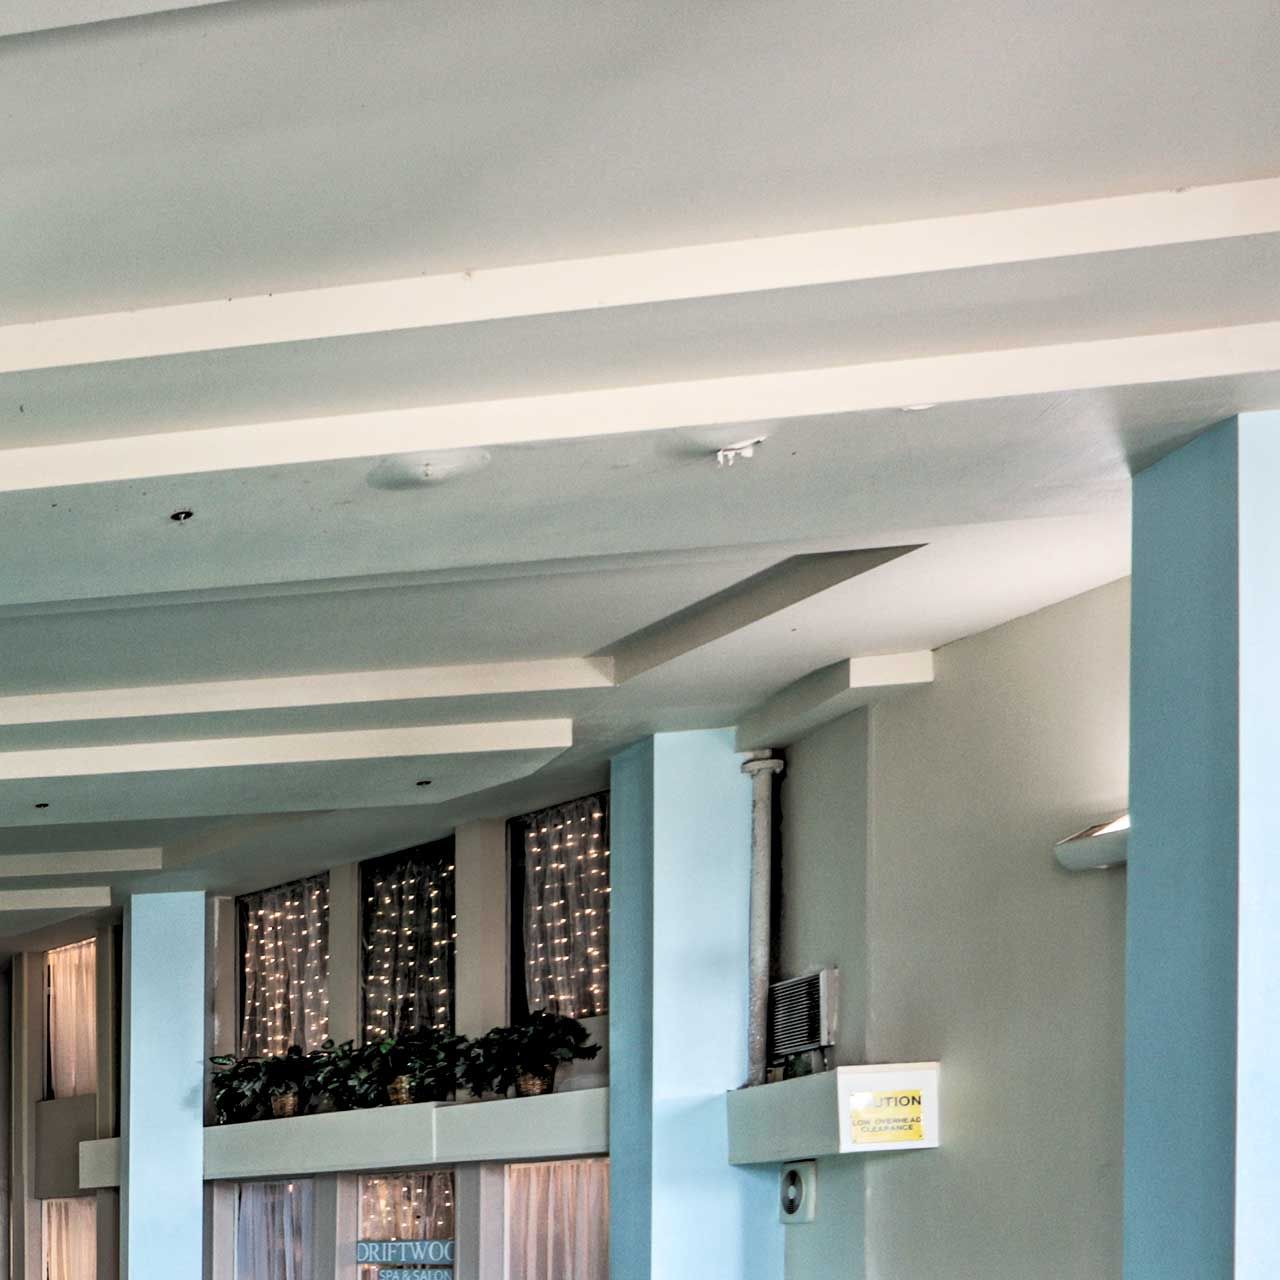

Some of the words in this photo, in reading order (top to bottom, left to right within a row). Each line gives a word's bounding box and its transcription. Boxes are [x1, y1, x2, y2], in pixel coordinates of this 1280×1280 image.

[866, 1095, 922, 1108] UTION
[851, 1119, 871, 1127] LOW
[874, 1116, 922, 1125] OVERHEAD
[860, 1124, 914, 1133] CLEARANCE
[357, 1241, 455, 1261] DRIFTWOO
